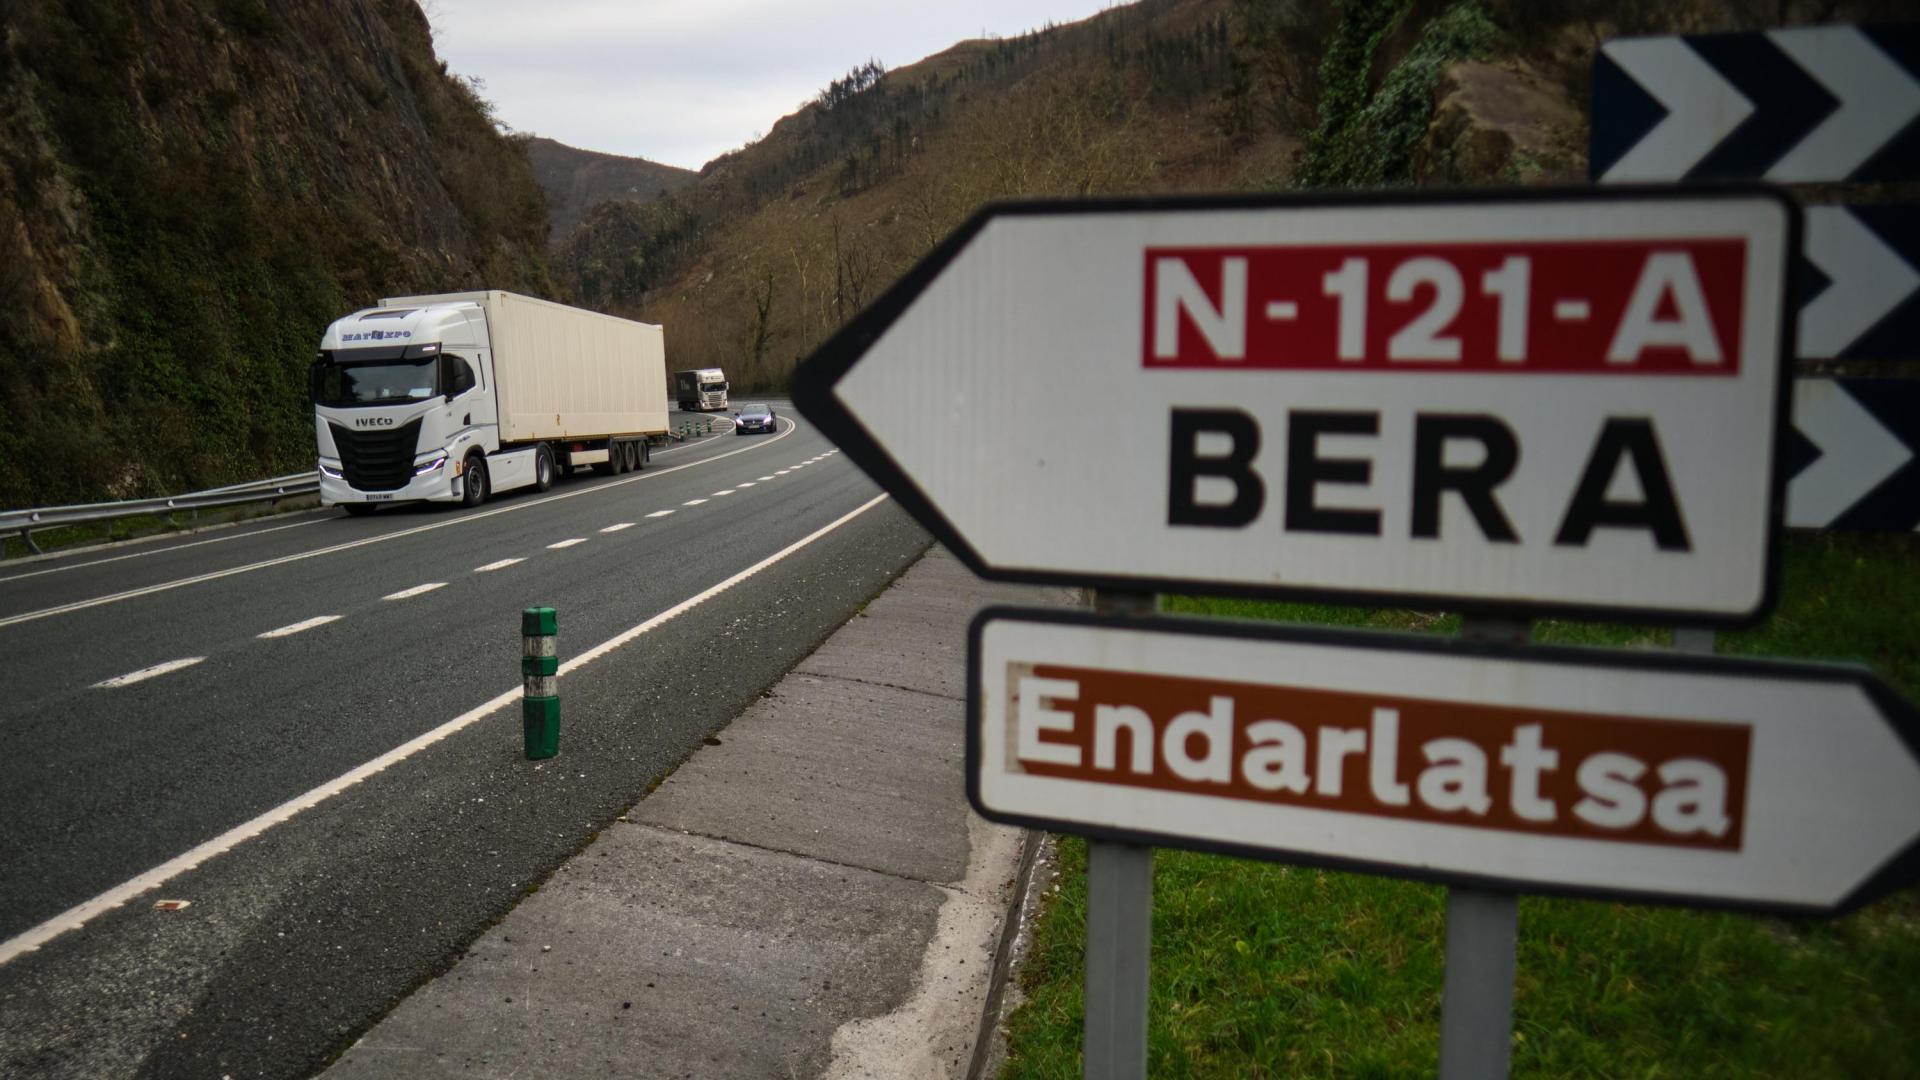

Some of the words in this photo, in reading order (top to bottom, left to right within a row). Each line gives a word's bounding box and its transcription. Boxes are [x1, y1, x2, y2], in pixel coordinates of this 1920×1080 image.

[1153, 251, 1724, 364] N-121-A
[355, 417, 393, 427] IVECO
[1167, 407, 1693, 552] BERA
[1017, 676, 1730, 837] Endarlatsa
